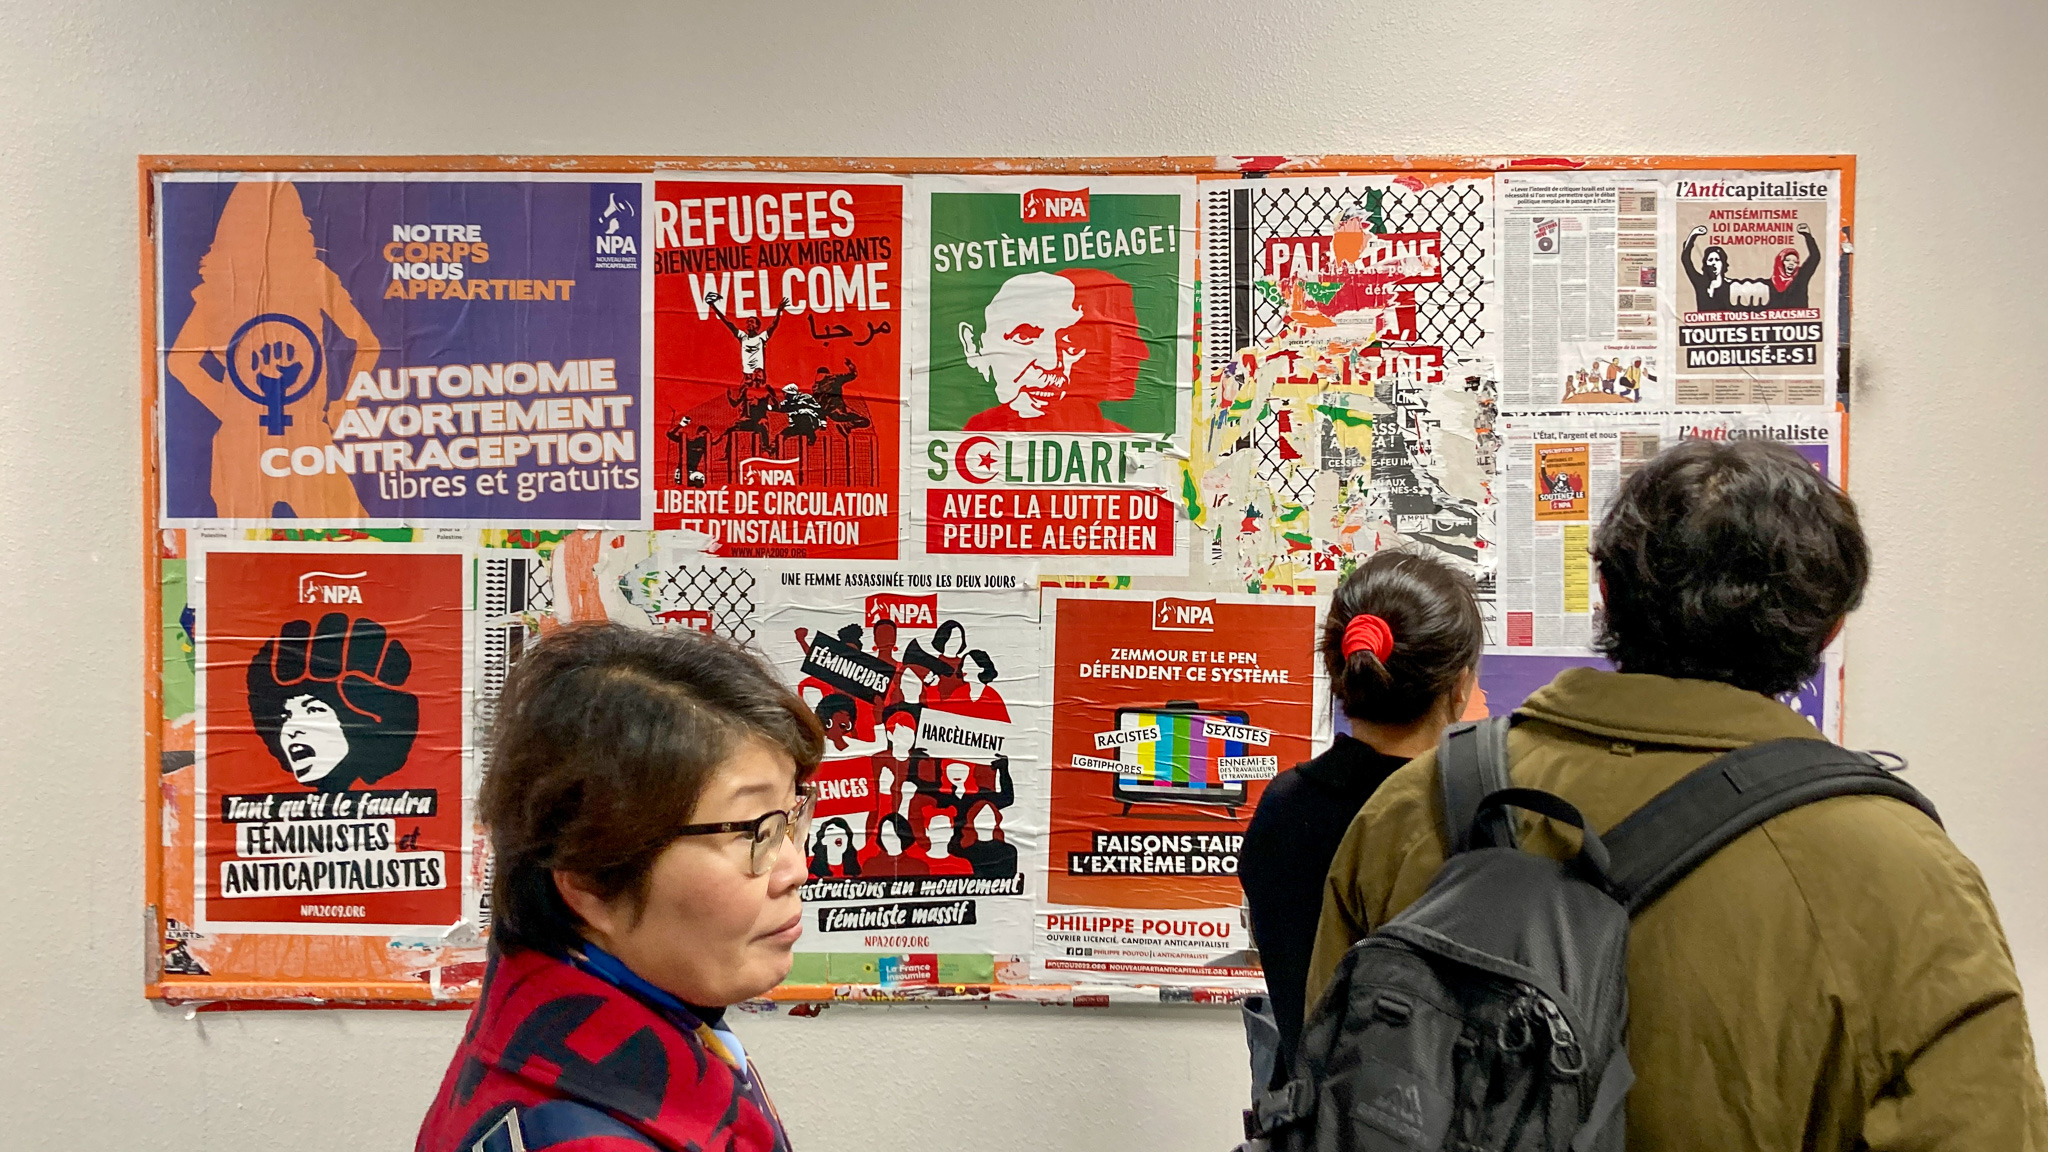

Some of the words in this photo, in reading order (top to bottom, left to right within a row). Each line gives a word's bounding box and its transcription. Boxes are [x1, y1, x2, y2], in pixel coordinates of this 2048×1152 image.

[1676, 180, 1827, 200] l'Anticapitaliste
[1046, 198, 1086, 218] NPA
[1709, 208, 1798, 219] ANTISÉMITISME
[654, 190, 854, 249] REFUGEES
[1713, 223, 1730, 232] LOI
[1734, 223, 1793, 232] DARMANIN
[392, 225, 481, 243] NOTRE
[1710, 236, 1794, 245] ISLAMOPHOBIE
[383, 242, 490, 263] CORPS
[597, 236, 637, 254] NPA
[654, 245, 752, 274] BIENVENUE
[758, 243, 793, 268] AUX
[798, 236, 891, 265] MIGRANTS
[934, 234, 1056, 272] SYSTÈME
[392, 262, 464, 280] NOUS
[383, 279, 576, 301] APPARTIENT
[688, 262, 890, 320] WELCOME
[1685, 313, 1722, 322] CONTRE
[1724, 312, 1749, 321] TOUS
[1751, 311, 1767, 320] LES
[1769, 310, 1818, 319] RACISMES
[1682, 327, 1747, 344] TOUTES
[1751, 326, 1771, 342] ET
[1772, 325, 1820, 341] TOUS
[346, 359, 616, 401] AUTONOMIE
[332, 395, 633, 440] AVORTEMENT
[1533, 431, 1557, 441] L'État,
[1558, 432, 1588, 440] l'argent
[1678, 424, 1828, 441] l'Anticapitaliste
[260, 431, 635, 477] CONTRACEPTION
[379, 470, 466, 500] libres
[476, 472, 508, 494] et
[517, 464, 639, 501] gratuits
[761, 470, 795, 485] NPA
[654, 486, 729, 514] LIBERTÉ
[735, 491, 759, 515] DE
[764, 491, 888, 516] CIRCULATION
[1540, 492, 1574, 500] SOUTENEZ
[943, 494, 1003, 519] AVEC
[1014, 494, 1041, 519] LA
[1051, 495, 1120, 520] LUTTE
[1129, 496, 1158, 520] DU
[709, 519, 859, 545] D'INSTALLATION
[944, 524, 1033, 550] PEUPLE
[1042, 521, 1156, 550] ALGÉRIEN
[781, 572, 800, 586] UNE
[805, 573, 841, 586] FEMME
[845, 572, 904, 587] ASSASSINÉE
[908, 574, 932, 587] TOUS
[936, 574, 952, 587] LES
[956, 575, 981, 588] DEUX
[984, 575, 1016, 588] JOURS
[323, 585, 362, 604] NPA
[889, 603, 933, 624] NPA
[1176, 606, 1213, 625] NPA
[1111, 648, 1188, 662] ZEMMOUR
[1192, 651, 1208, 662] ET
[1211, 651, 1225, 663] LE
[1229, 653, 1257, 665] PEN
[810, 646, 890, 693] FÉMINICIDES
[1079, 660, 1181, 681] DÉFENDENT
[1186, 666, 1206, 682] CE
[1211, 665, 1288, 684] SYSTÈME
[922, 723, 1005, 751] HARCÈLEMENT
[1098, 728, 1158, 747] RACISTES
[1206, 723, 1268, 743] SEXISTES
[1073, 756, 1142, 775] LGBTIPHOBES
[227, 796, 274, 819] Tant
[279, 793, 326, 821] qu'il
[332, 795, 350, 817] le
[357, 791, 431, 819] faudra
[246, 820, 389, 855] FÉMINISTES
[399, 826, 421, 851] et
[1097, 835, 1193, 853] FAISONS
[1198, 836, 1244, 853] TAIR
[1073, 852, 1186, 873] L'EXTRÊME
[1192, 856, 1238, 873] DRO
[225, 858, 440, 894] ANTICAPITALISTES
[799, 878, 887, 901] nstruisons
[891, 881, 914, 896] un
[920, 877, 1021, 895] mouvement
[300, 905, 366, 918] NPA2009.ORG
[826, 902, 907, 932] féministe
[912, 900, 970, 925] massif
[1047, 915, 1135, 933] PHILIPPE
[1143, 920, 1230, 938] POUTOU
[865, 936, 930, 948] NPA2009.ORG
[1122, 937, 1162, 946] CANDIDAT
[1164, 940, 1229, 948] ANTICAPITALISTE
[886, 971, 931, 980] insoumise
[900, 963, 931, 972] France
